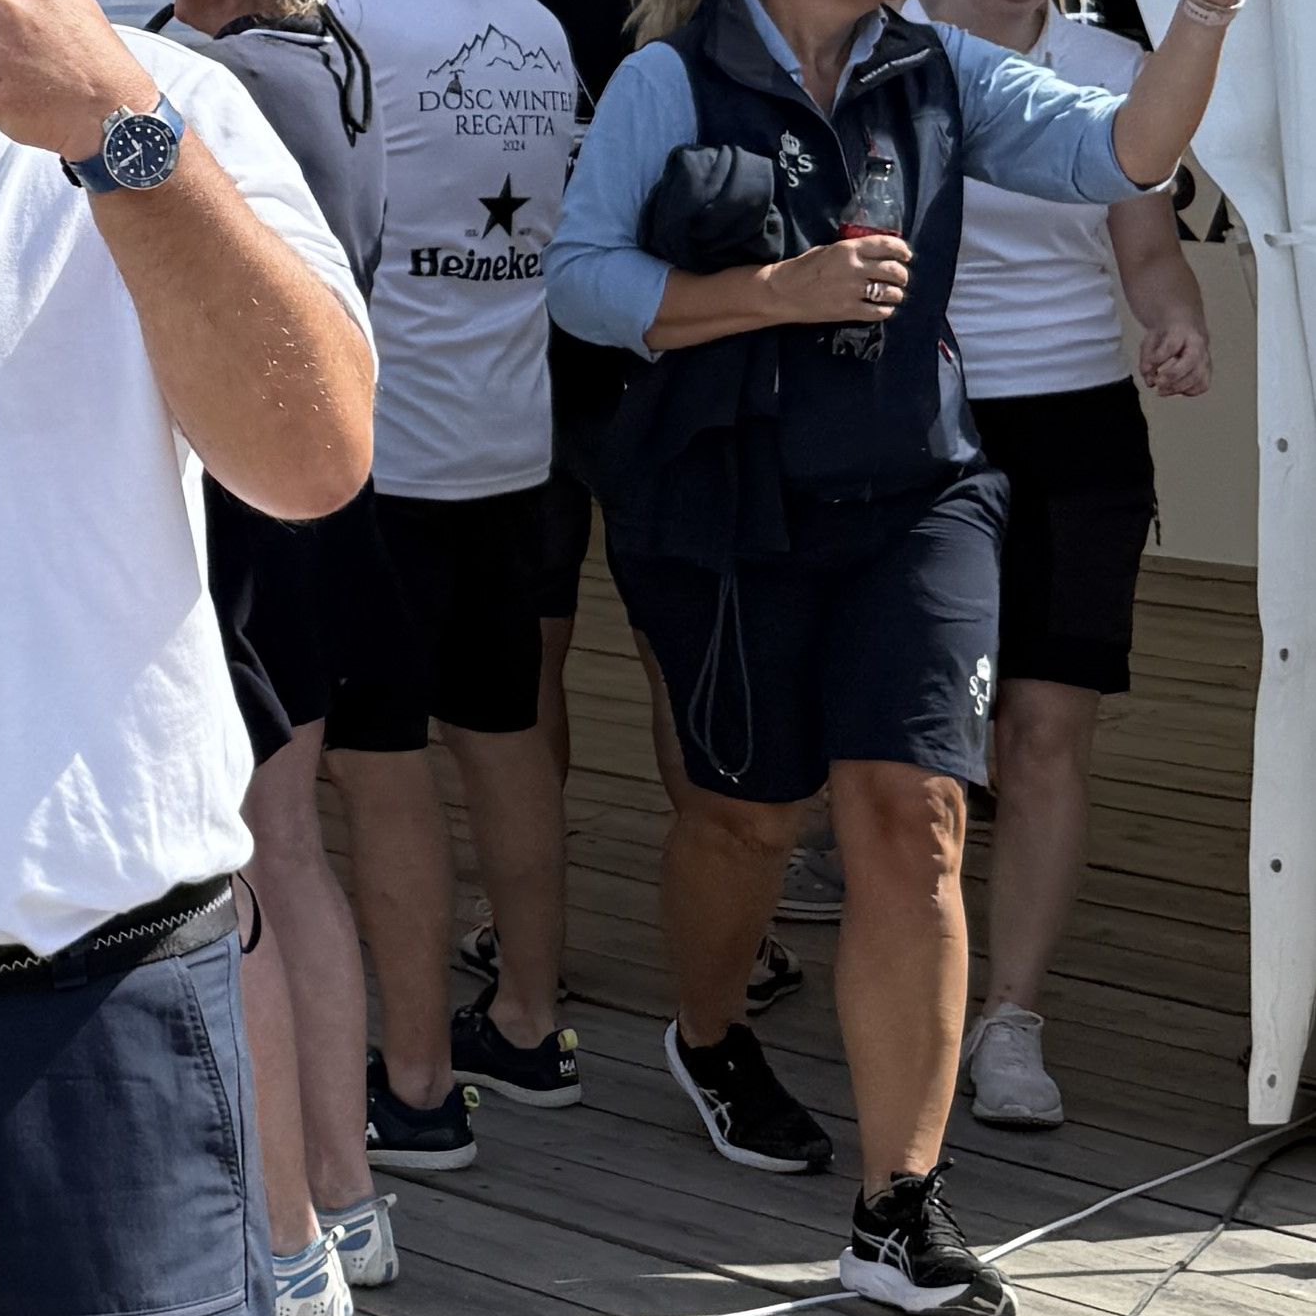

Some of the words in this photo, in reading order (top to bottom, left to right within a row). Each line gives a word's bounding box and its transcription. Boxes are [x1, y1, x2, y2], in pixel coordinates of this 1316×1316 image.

[419, 88, 493, 112] DOSC
[456, 114, 555, 135] REGATTA
[408, 246, 544, 282] Heineke
